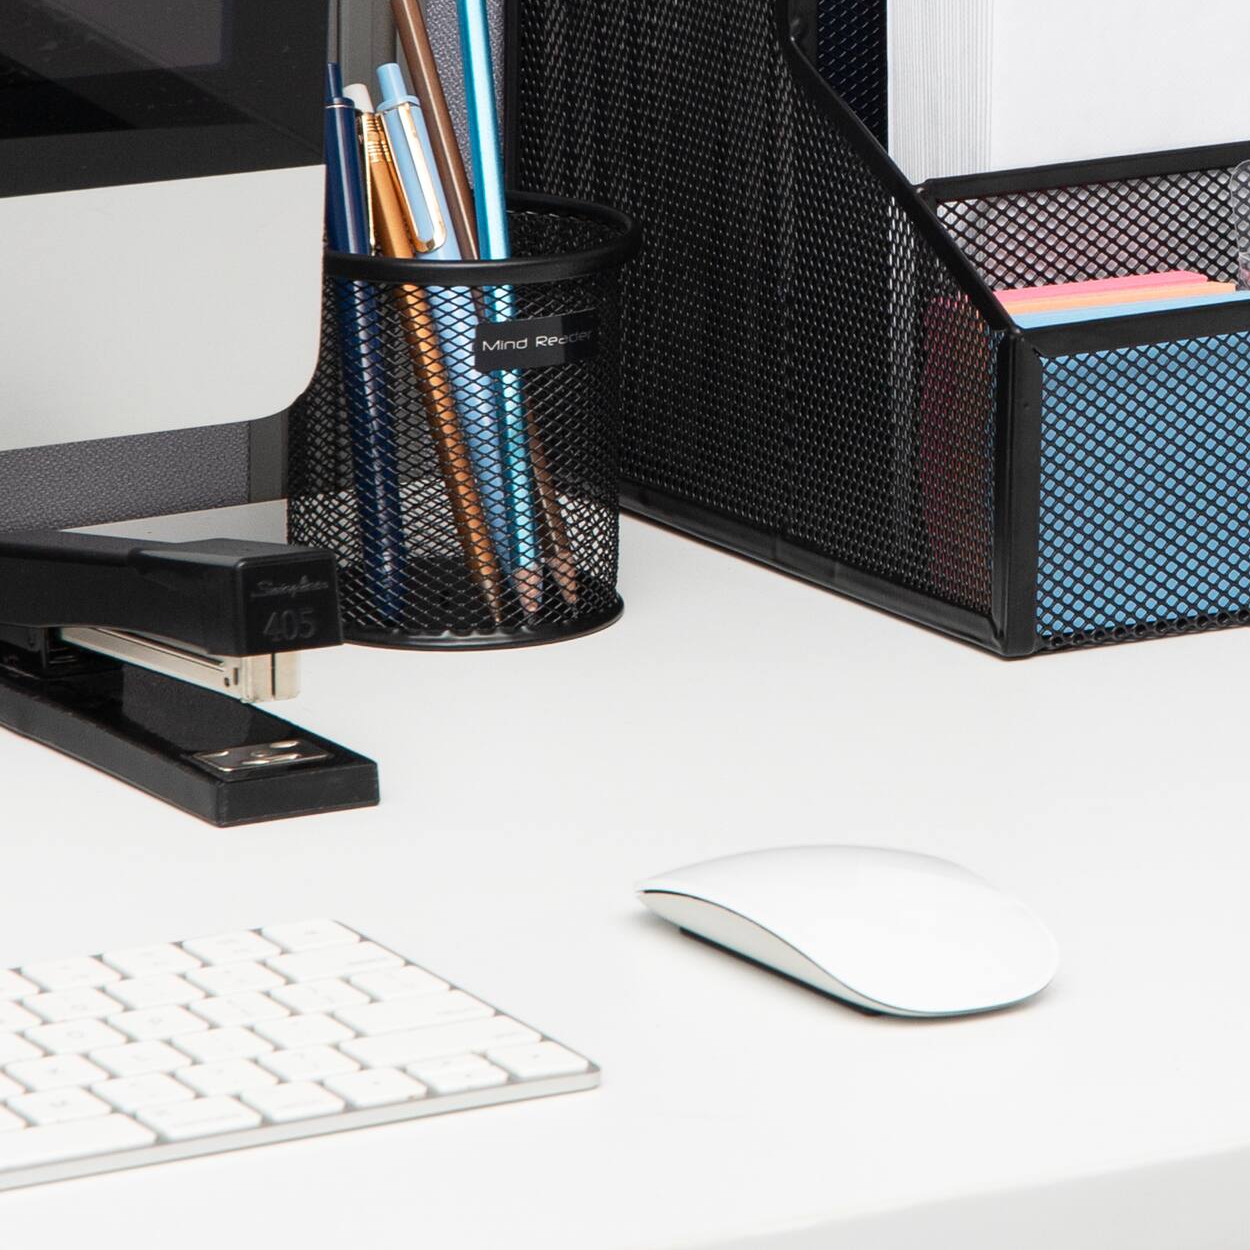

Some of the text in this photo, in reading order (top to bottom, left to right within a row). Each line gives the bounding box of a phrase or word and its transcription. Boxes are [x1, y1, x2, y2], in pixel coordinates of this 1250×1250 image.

[482, 330, 592, 352] Mind Reader
[263, 607, 317, 642] 405
